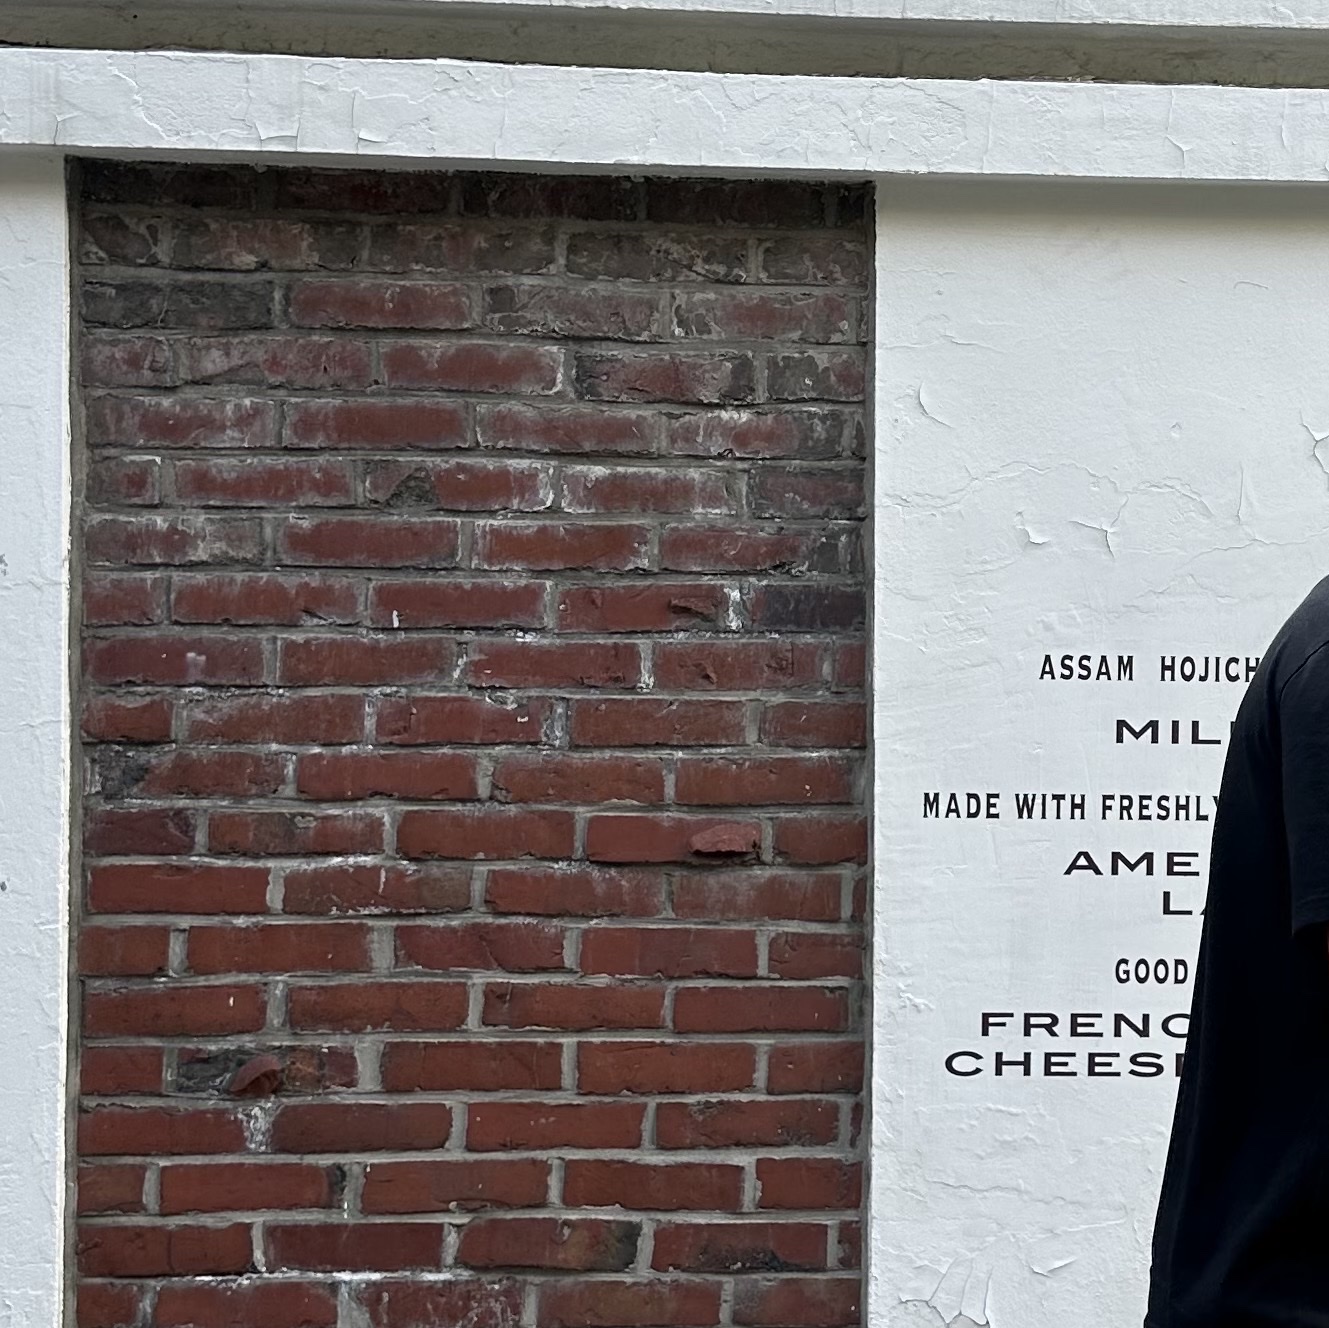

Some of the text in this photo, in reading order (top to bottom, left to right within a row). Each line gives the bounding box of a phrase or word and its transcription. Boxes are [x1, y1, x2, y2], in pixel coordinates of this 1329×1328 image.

[1039, 655, 1134, 681] ASSAM
[1115, 719, 1235, 745] MIL
[922, 792, 1000, 819] MADE
[1014, 793, 1086, 820] WITH
[1162, 890, 1206, 916] L
[1115, 958, 1188, 985] GOOD
[944, 1050, 1185, 1078] CHEES
